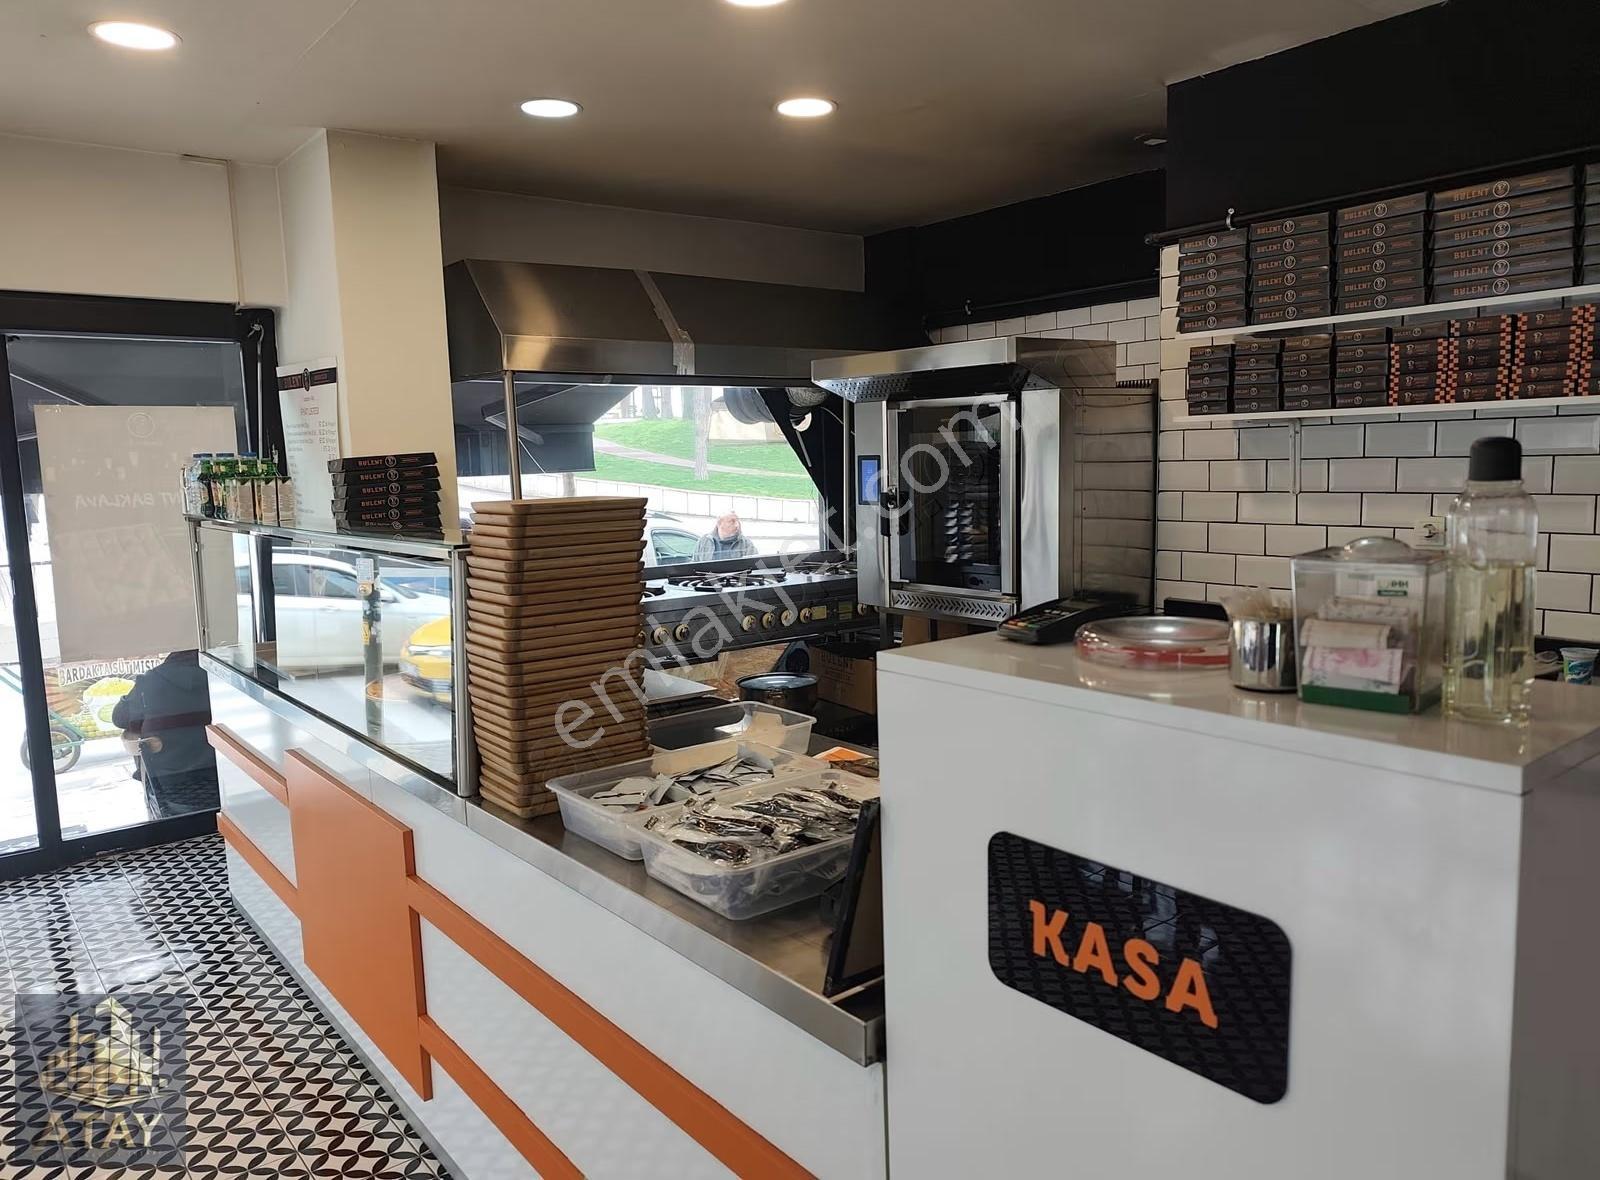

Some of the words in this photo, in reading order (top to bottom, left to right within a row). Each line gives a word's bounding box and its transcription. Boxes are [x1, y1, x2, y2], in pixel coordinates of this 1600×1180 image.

[59, 662, 110, 686] BARDAKTA
[111, 658, 131, 675] SÜT
[1029, 899, 1219, 1029] KASA
